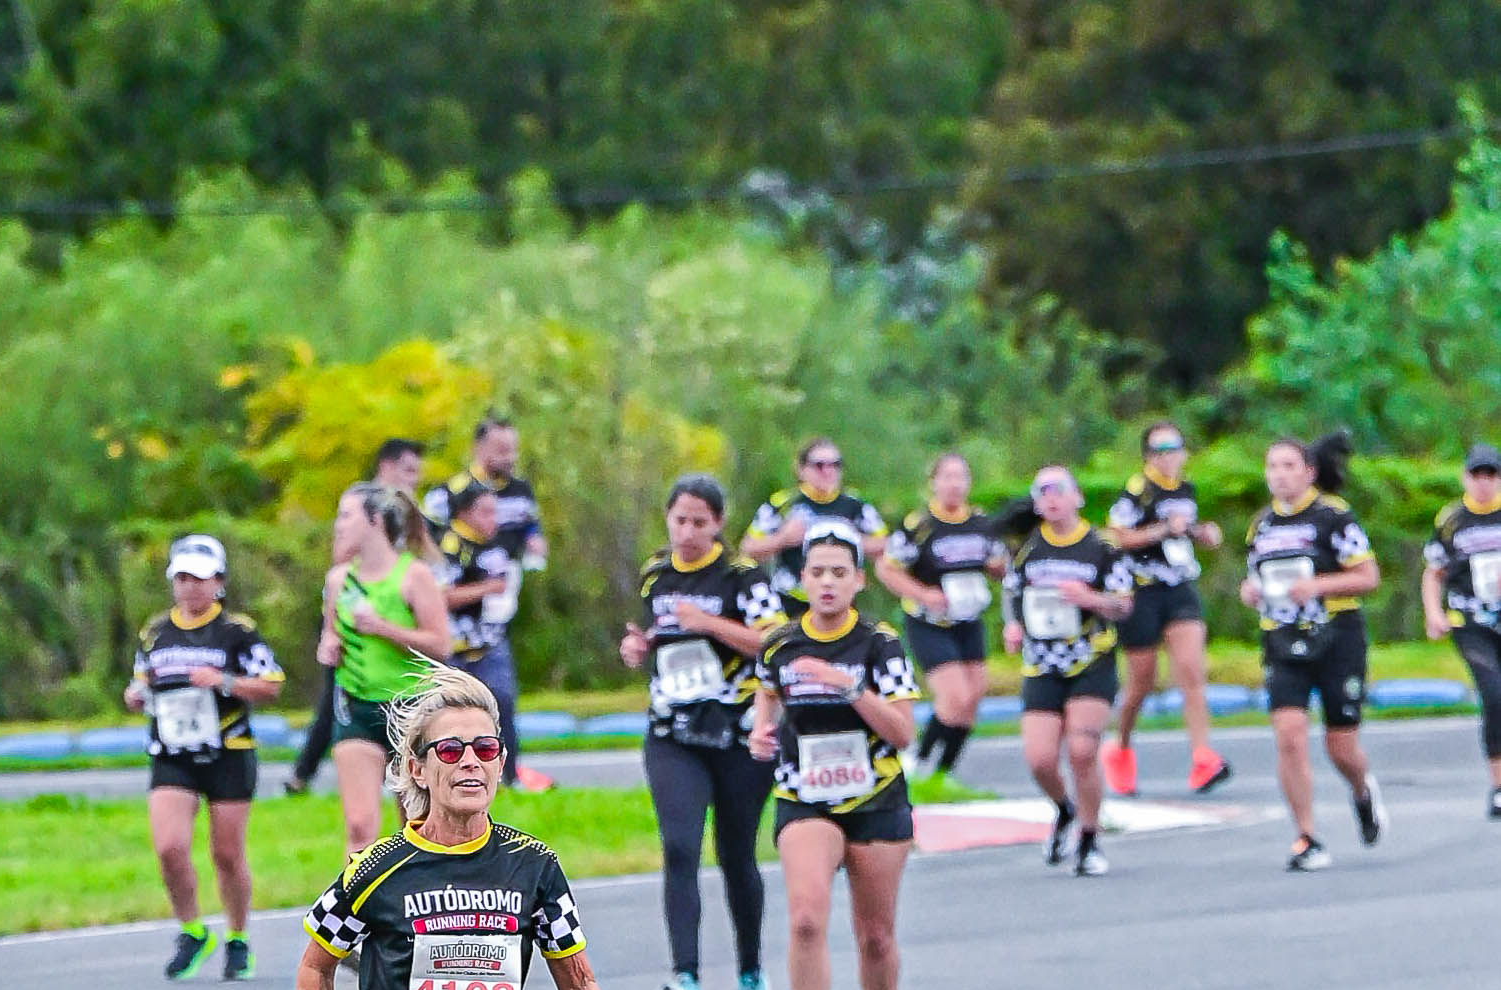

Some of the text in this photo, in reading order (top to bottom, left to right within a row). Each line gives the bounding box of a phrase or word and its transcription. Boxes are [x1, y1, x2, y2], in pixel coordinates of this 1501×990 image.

[403, 884, 522, 918] AUTÓDROMO
[424, 914, 508, 932] RUNNING RACE
[430, 940, 506, 960] AUTÓDROMO
